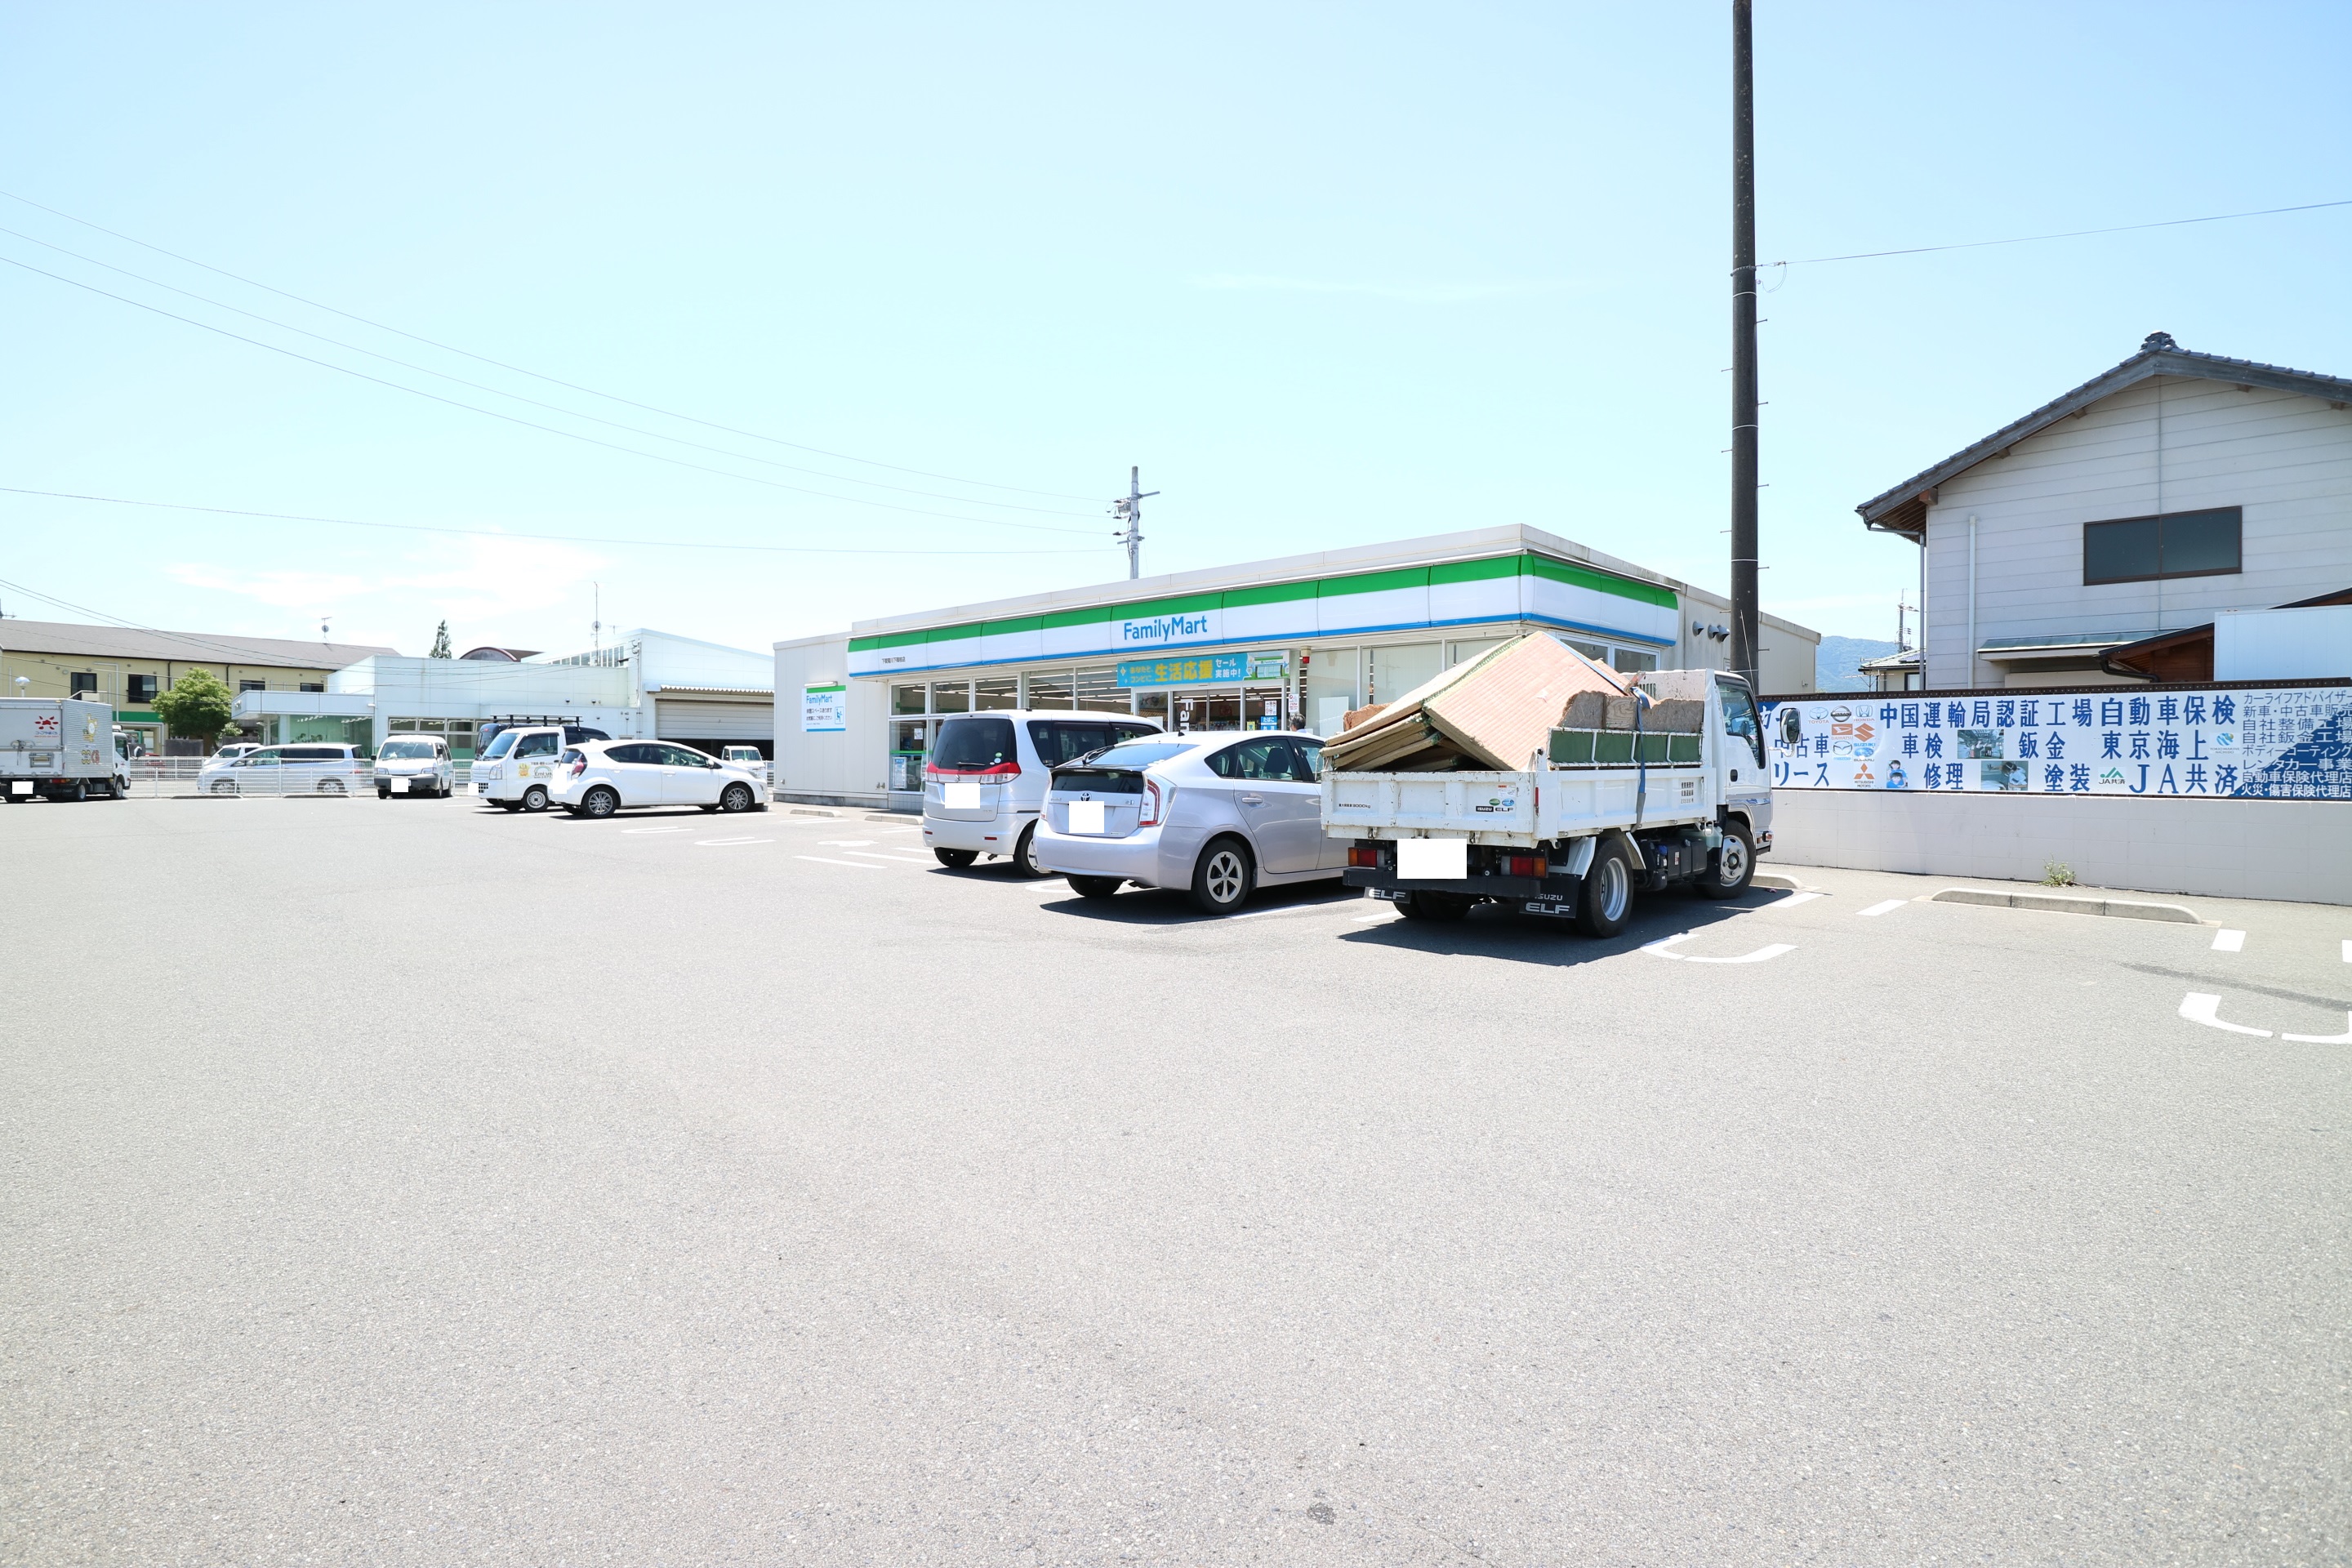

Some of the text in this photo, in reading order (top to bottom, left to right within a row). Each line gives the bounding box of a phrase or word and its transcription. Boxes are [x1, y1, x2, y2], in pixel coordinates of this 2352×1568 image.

[1124, 615, 1208, 642] FamilyMart
[1215, 658, 1236, 667] セール
[1155, 660, 1213, 682] 生活応援
[806, 694, 832, 706] FamilyMart
[2243, 703, 2352, 718] 新車・中古車販売
[2243, 717, 2352, 731] 自社整備工場
[2100, 729, 2209, 760] 東京海上
[2243, 730, 2352, 744] 自社鈑金工場
[1775, 733, 1830, 758] 中古車
[1901, 732, 1943, 759] 車検
[2019, 731, 2066, 760] 鈑金
[2243, 744, 2352, 758] ボディーコーティング
[2243, 758, 2352, 771] レンタカー事業
[1774, 761, 1830, 787] リース
[1924, 762, 1964, 790] 修理
[2044, 763, 2091, 792] 塗装
[2128, 763, 2239, 795] JA共済
[2243, 770, 2352, 784] 自動車保険代理店
[2241, 783, 2351, 798] 火災・傷害保険代理店
[1369, 889, 1406, 900] ELF
[1526, 902, 1570, 914] ELF
